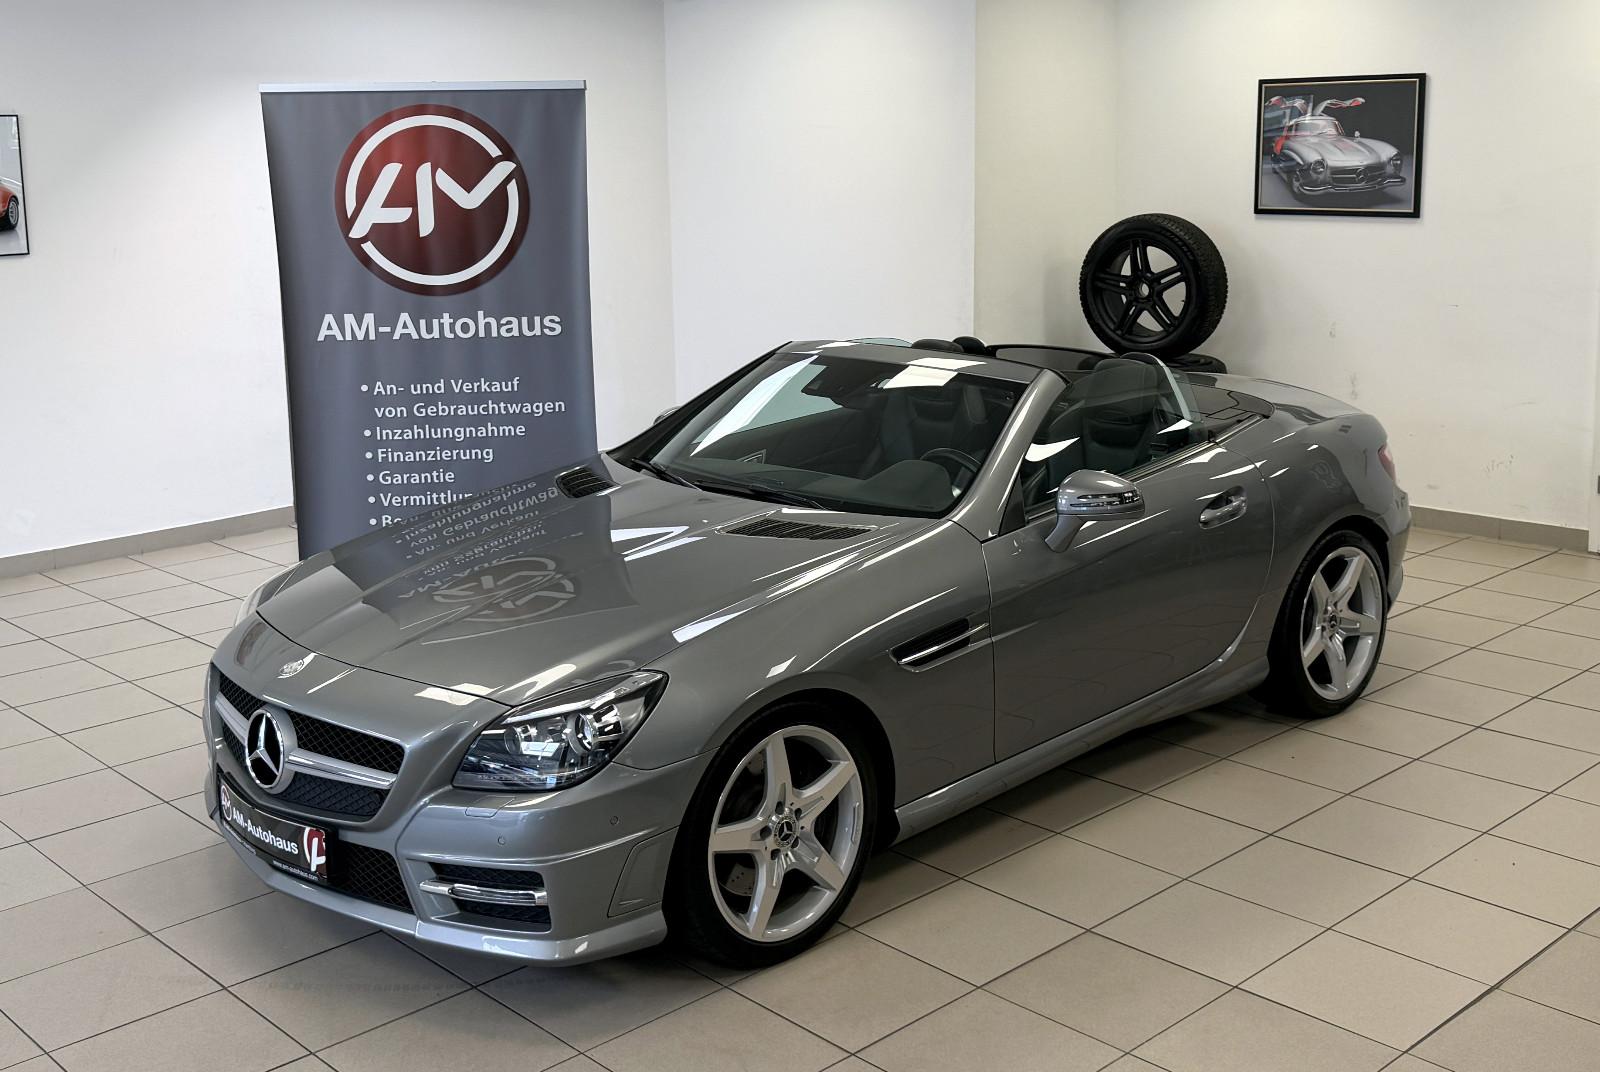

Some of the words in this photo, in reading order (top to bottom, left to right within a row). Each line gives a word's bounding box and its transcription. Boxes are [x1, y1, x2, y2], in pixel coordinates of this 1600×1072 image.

[316, 311, 562, 342] AM-Autohaus
[373, 381, 405, 396] An-
[410, 379, 445, 395] und
[451, 377, 520, 393] Verkauf
[374, 405, 407, 418] von
[413, 400, 566, 417] Gebrauchtwagen
[376, 422, 526, 442] Inzahlungnahme
[377, 447, 494, 463] Finanzierung
[379, 469, 455, 485] Garantie
[233, 807, 299, 855] AM-Autohaus
